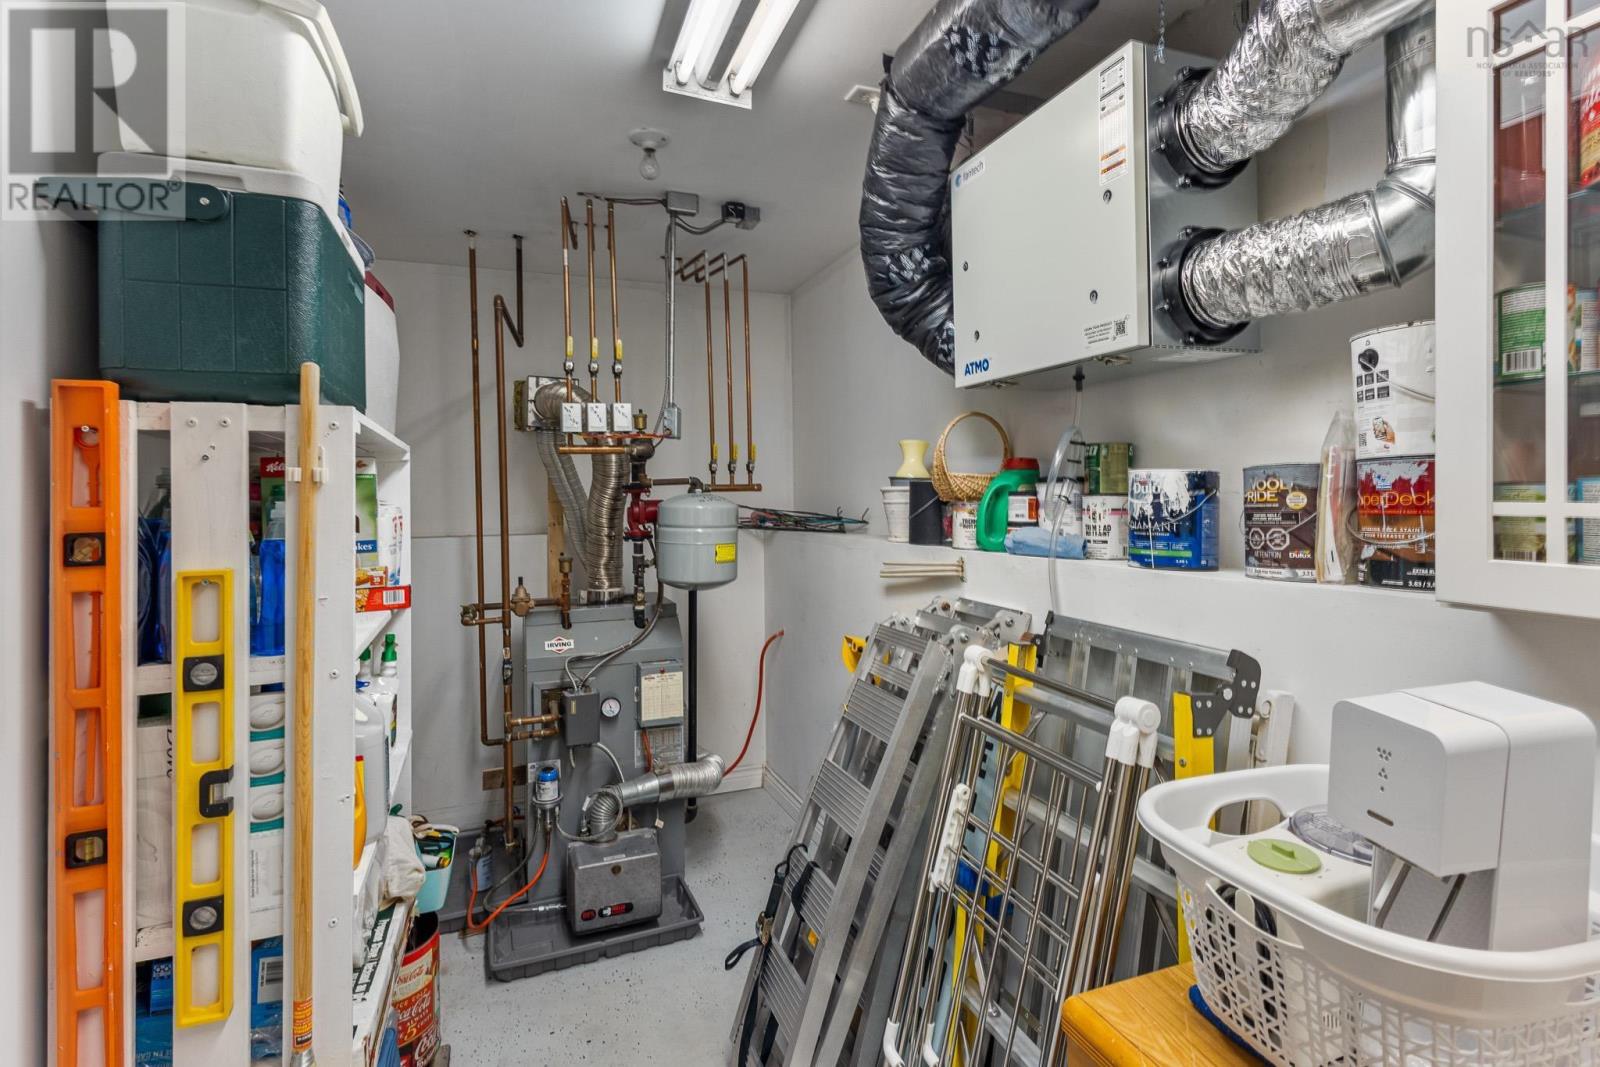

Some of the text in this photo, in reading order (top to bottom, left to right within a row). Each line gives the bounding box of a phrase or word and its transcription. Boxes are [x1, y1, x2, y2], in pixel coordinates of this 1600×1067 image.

[964, 358, 990, 376] ATMO
[1289, 551, 1312, 559] Dulux
[547, 641, 572, 649] IRVING
